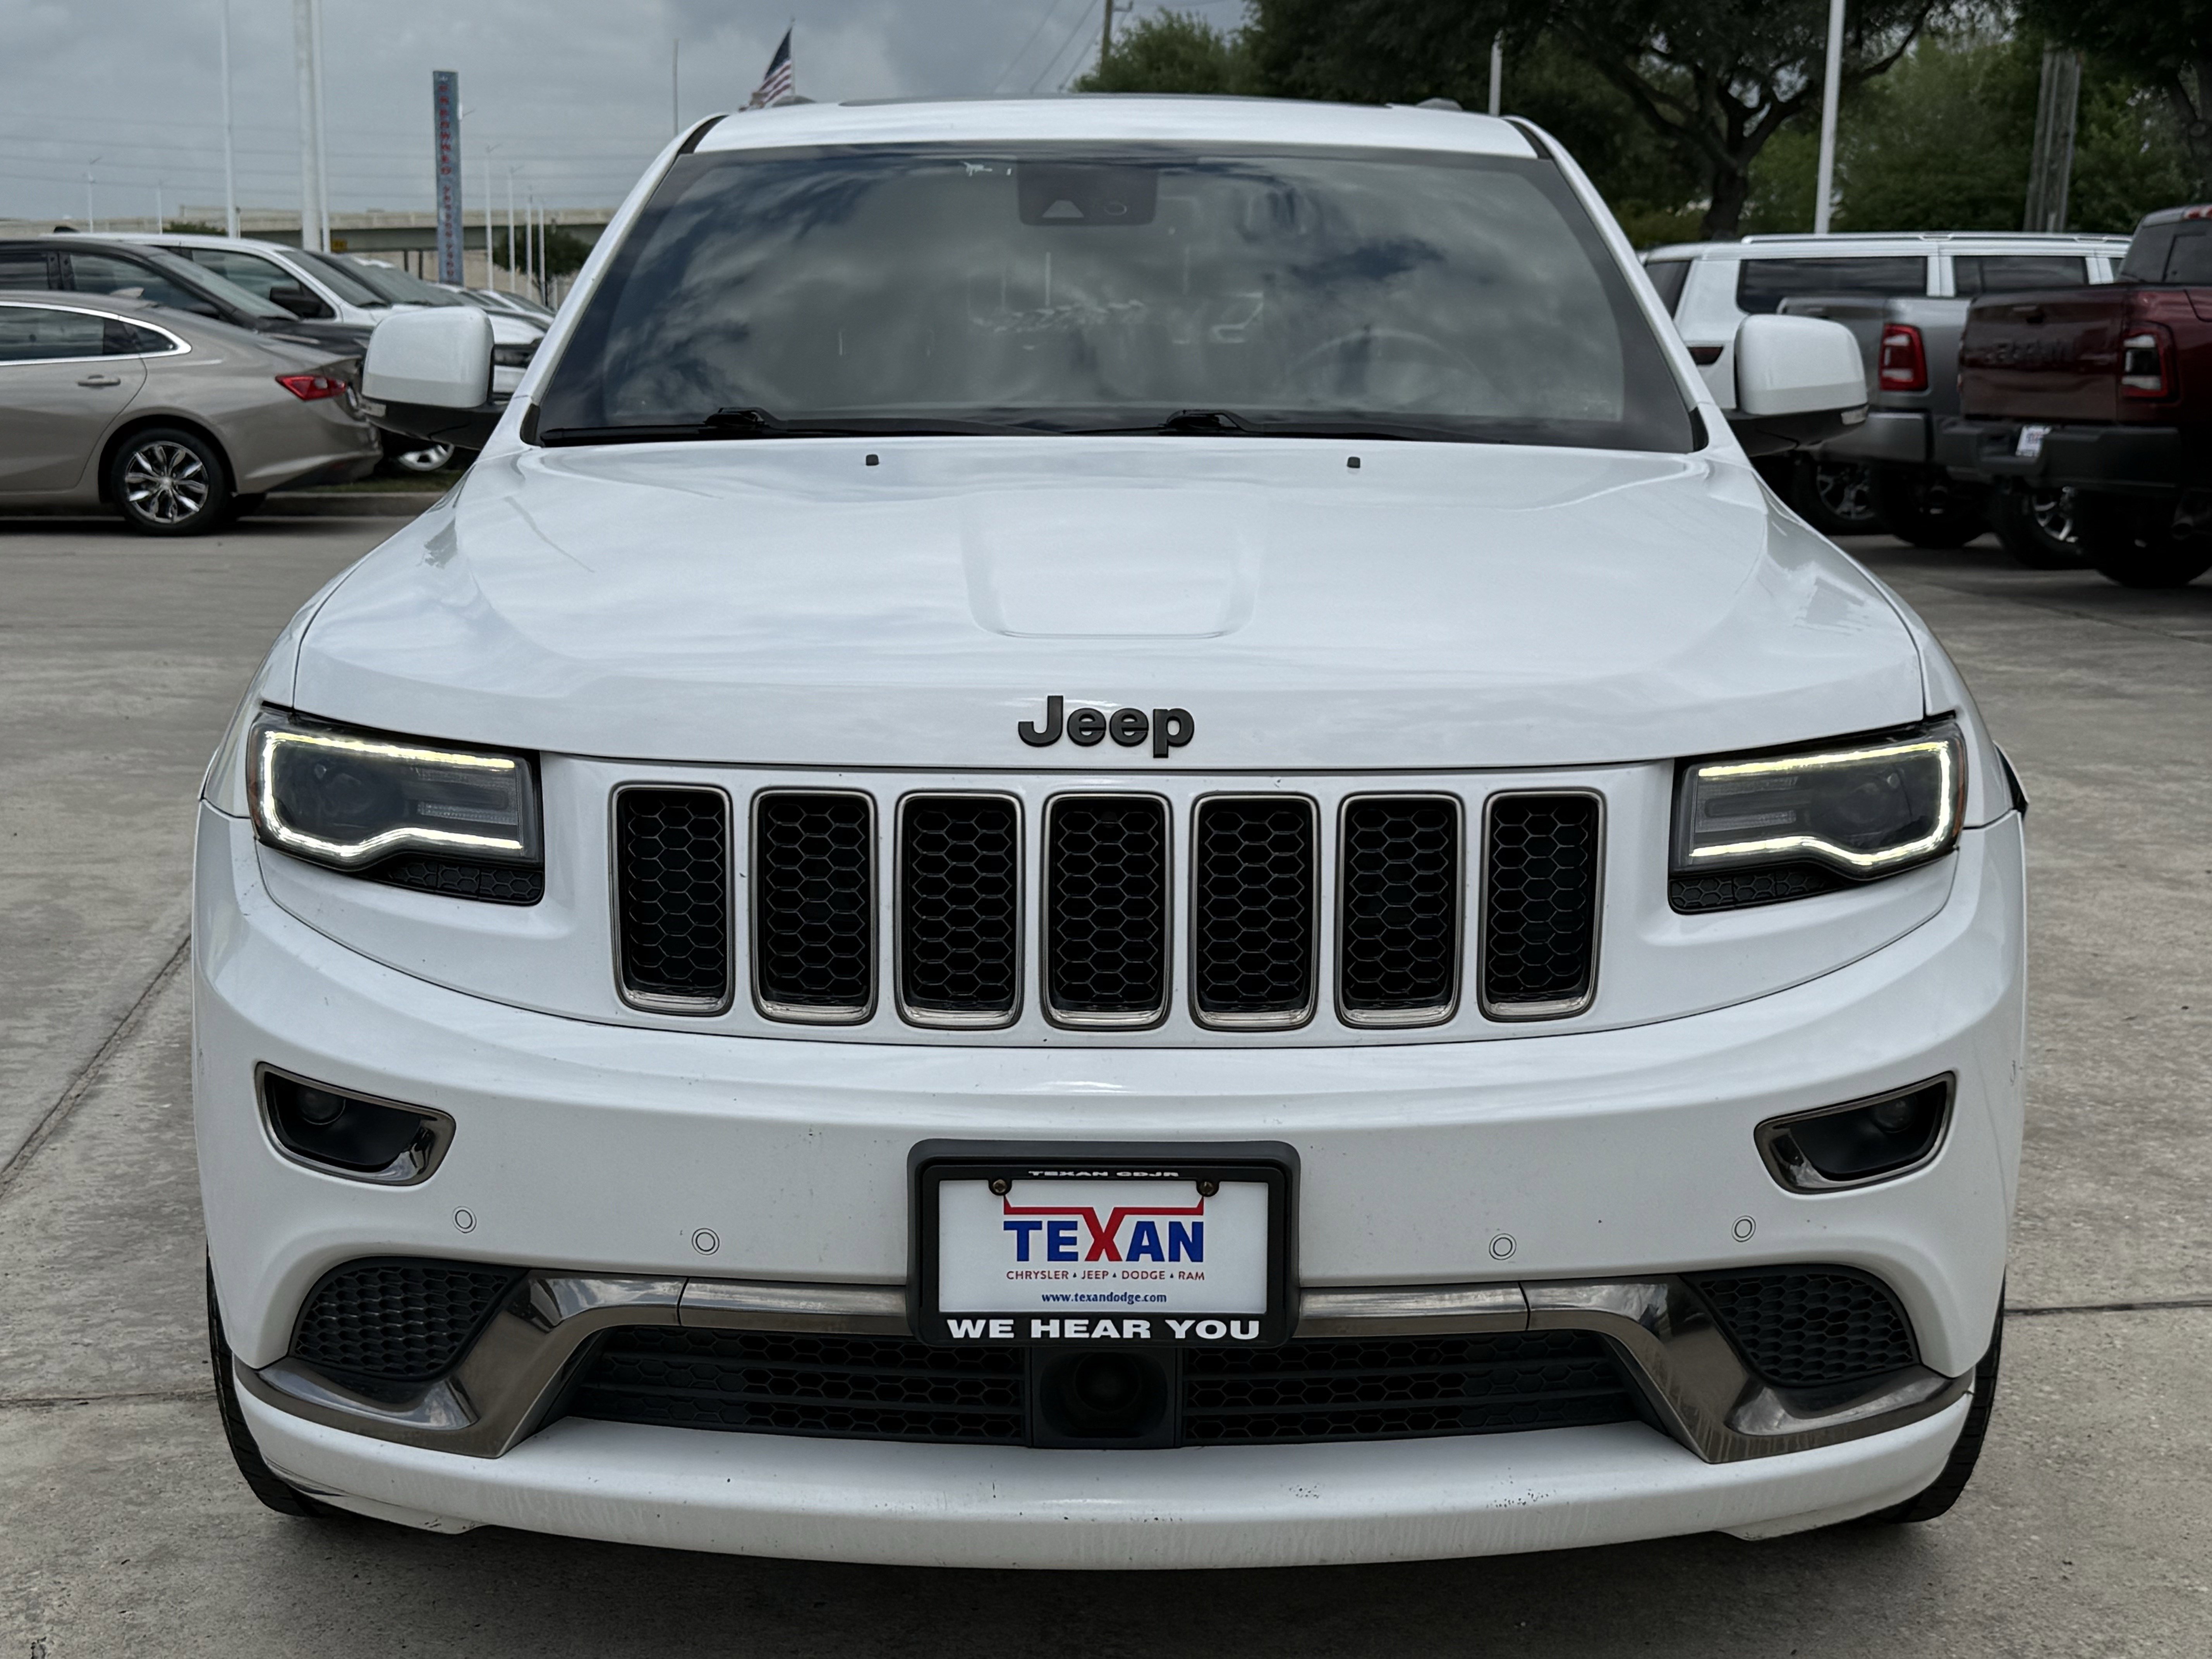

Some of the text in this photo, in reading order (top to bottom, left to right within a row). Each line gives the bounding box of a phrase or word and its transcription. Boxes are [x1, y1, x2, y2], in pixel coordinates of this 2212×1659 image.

[1018, 695, 1195, 758] Jeep
[1004, 1207, 1203, 1262] TEXAN
[1006, 1270, 1205, 1281] CHRYSLER JEEP DODGE RAM
[1041, 1291, 1167, 1305] www.texandodge.com
[947, 1319, 1260, 1340] WE HEAR YOU
